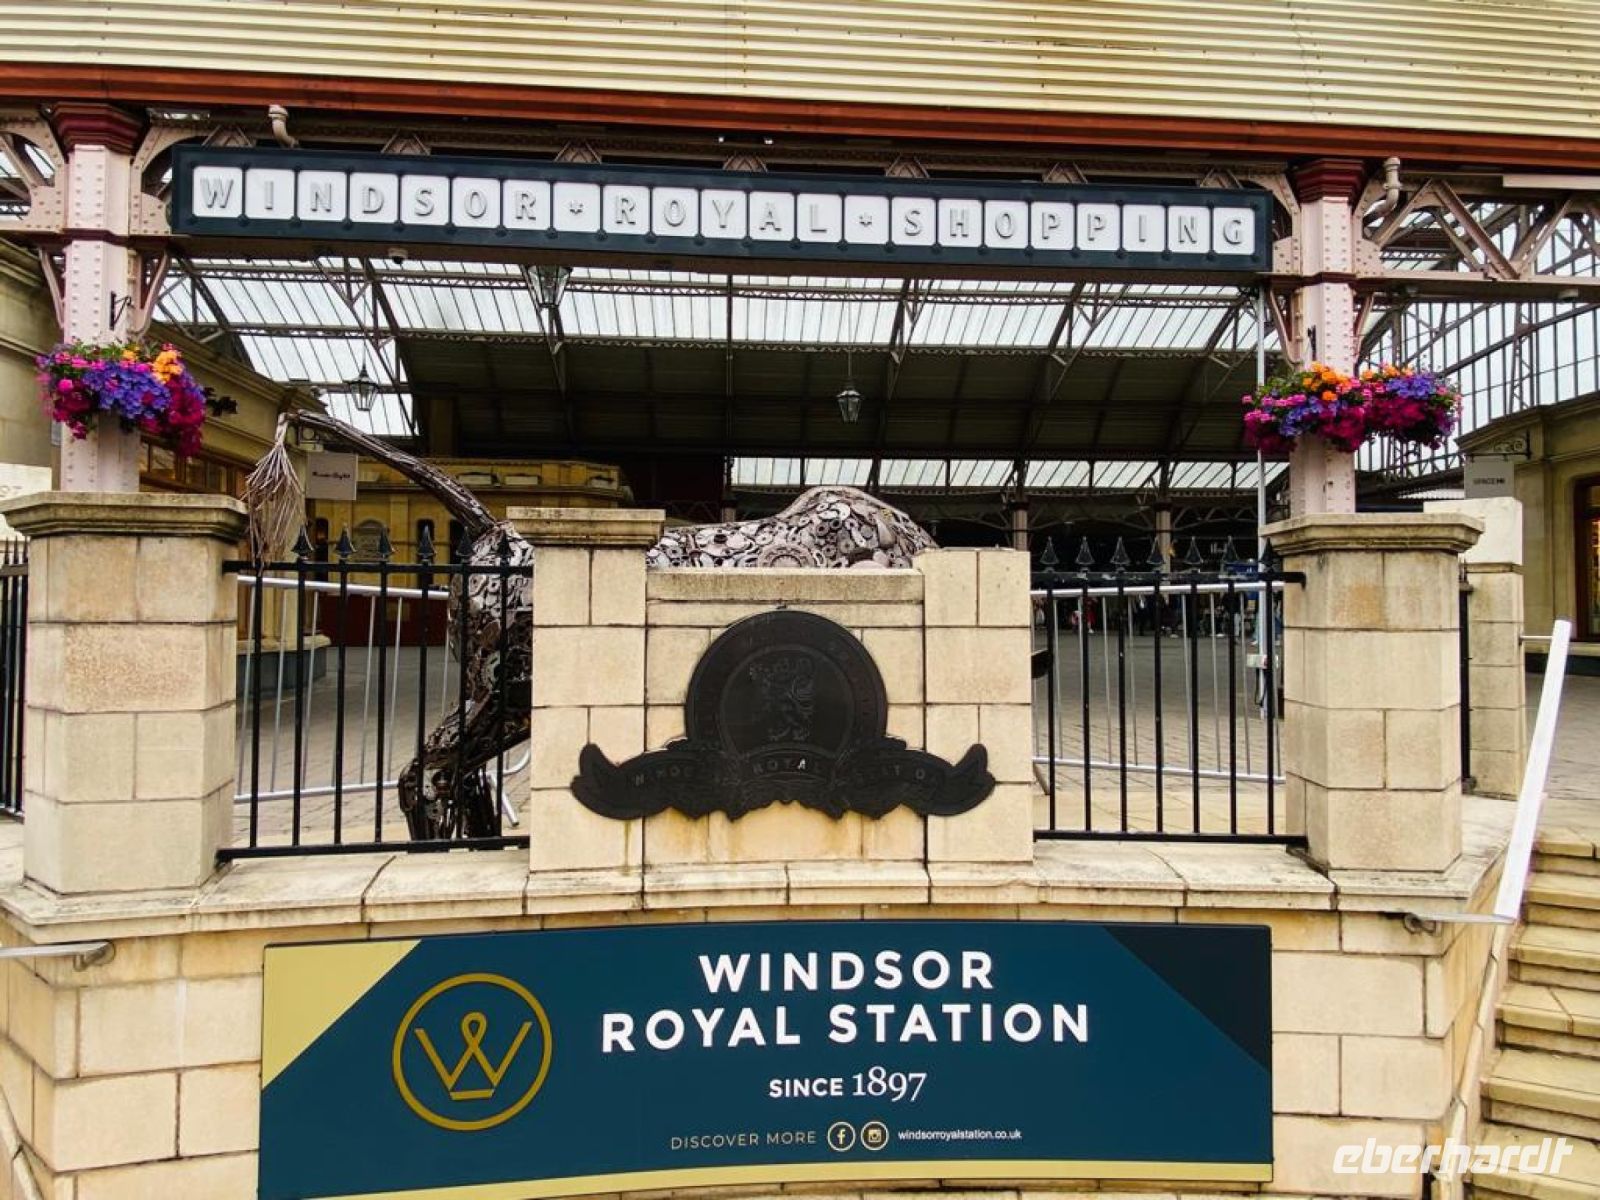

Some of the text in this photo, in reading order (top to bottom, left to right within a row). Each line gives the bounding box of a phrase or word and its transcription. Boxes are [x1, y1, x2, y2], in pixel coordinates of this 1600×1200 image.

[200, 177, 1244, 246] WINDSOR ROYAL SHOPPING
[699, 949, 993, 993] WINDSOR
[602, 1003, 1089, 1053] ROYAL STATION
[769, 1066, 927, 1102] SINCE 1897
[671, 1133, 759, 1150] DISCOVER
[766, 1130, 817, 1146] MORE
[898, 1128, 1022, 1142] windsorroyalstation.co.uk
